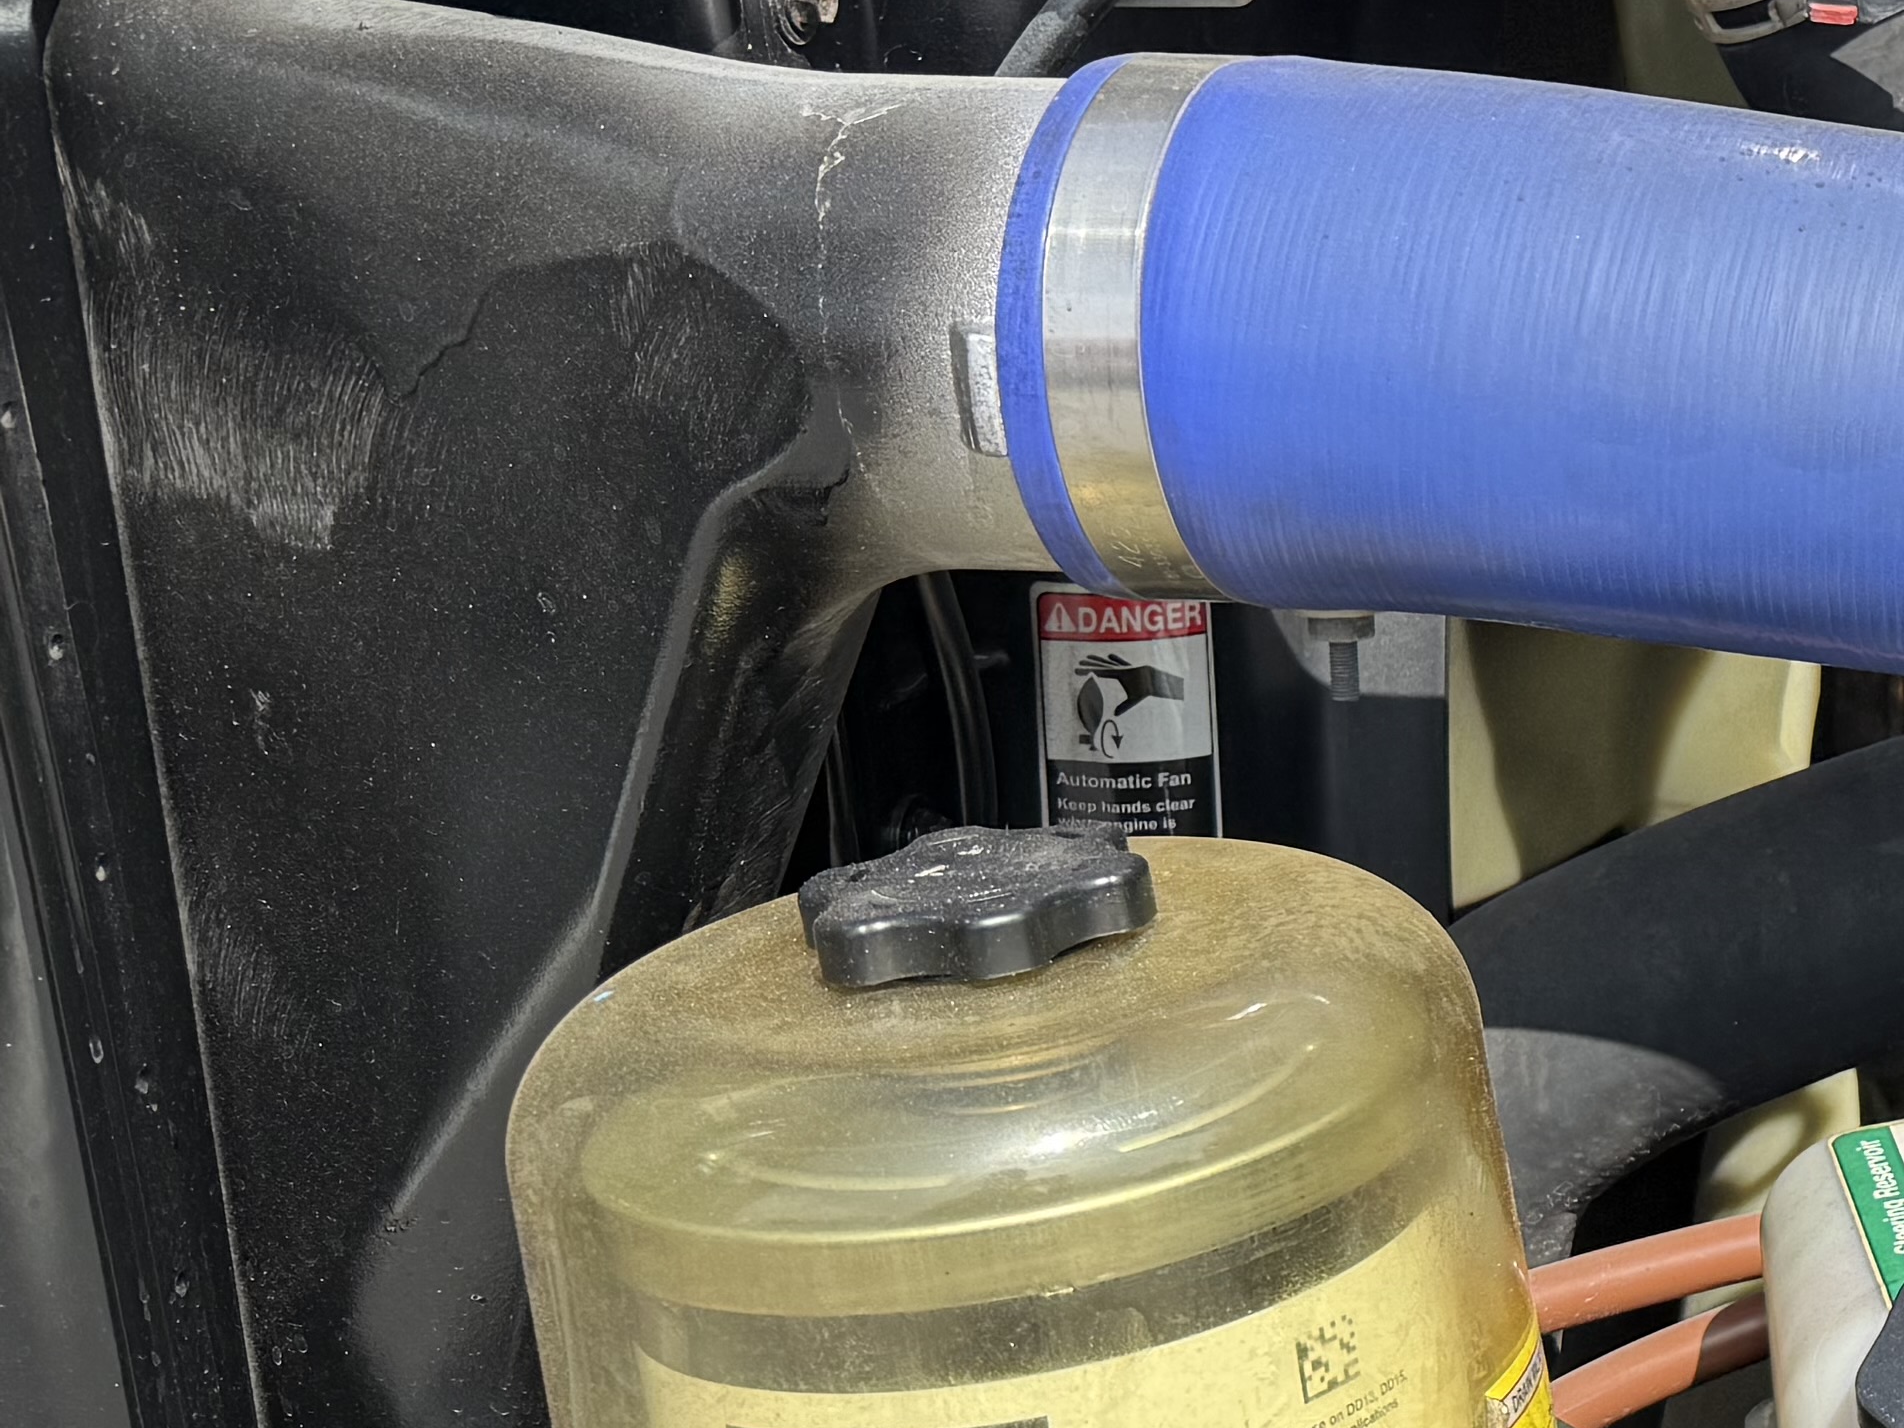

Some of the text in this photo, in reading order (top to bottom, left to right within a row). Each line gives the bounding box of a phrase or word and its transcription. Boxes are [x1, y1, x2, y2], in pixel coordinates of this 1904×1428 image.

[1077, 601, 1202, 634] DANGER
[1056, 771, 1192, 789] Automatic Fan
[1057, 797, 1196, 814] Keep hands clear
[1162, 817, 1177, 829] is
[1856, 1140, 1900, 1199] Reservoir
[1329, 1410, 1346, 1427] on
